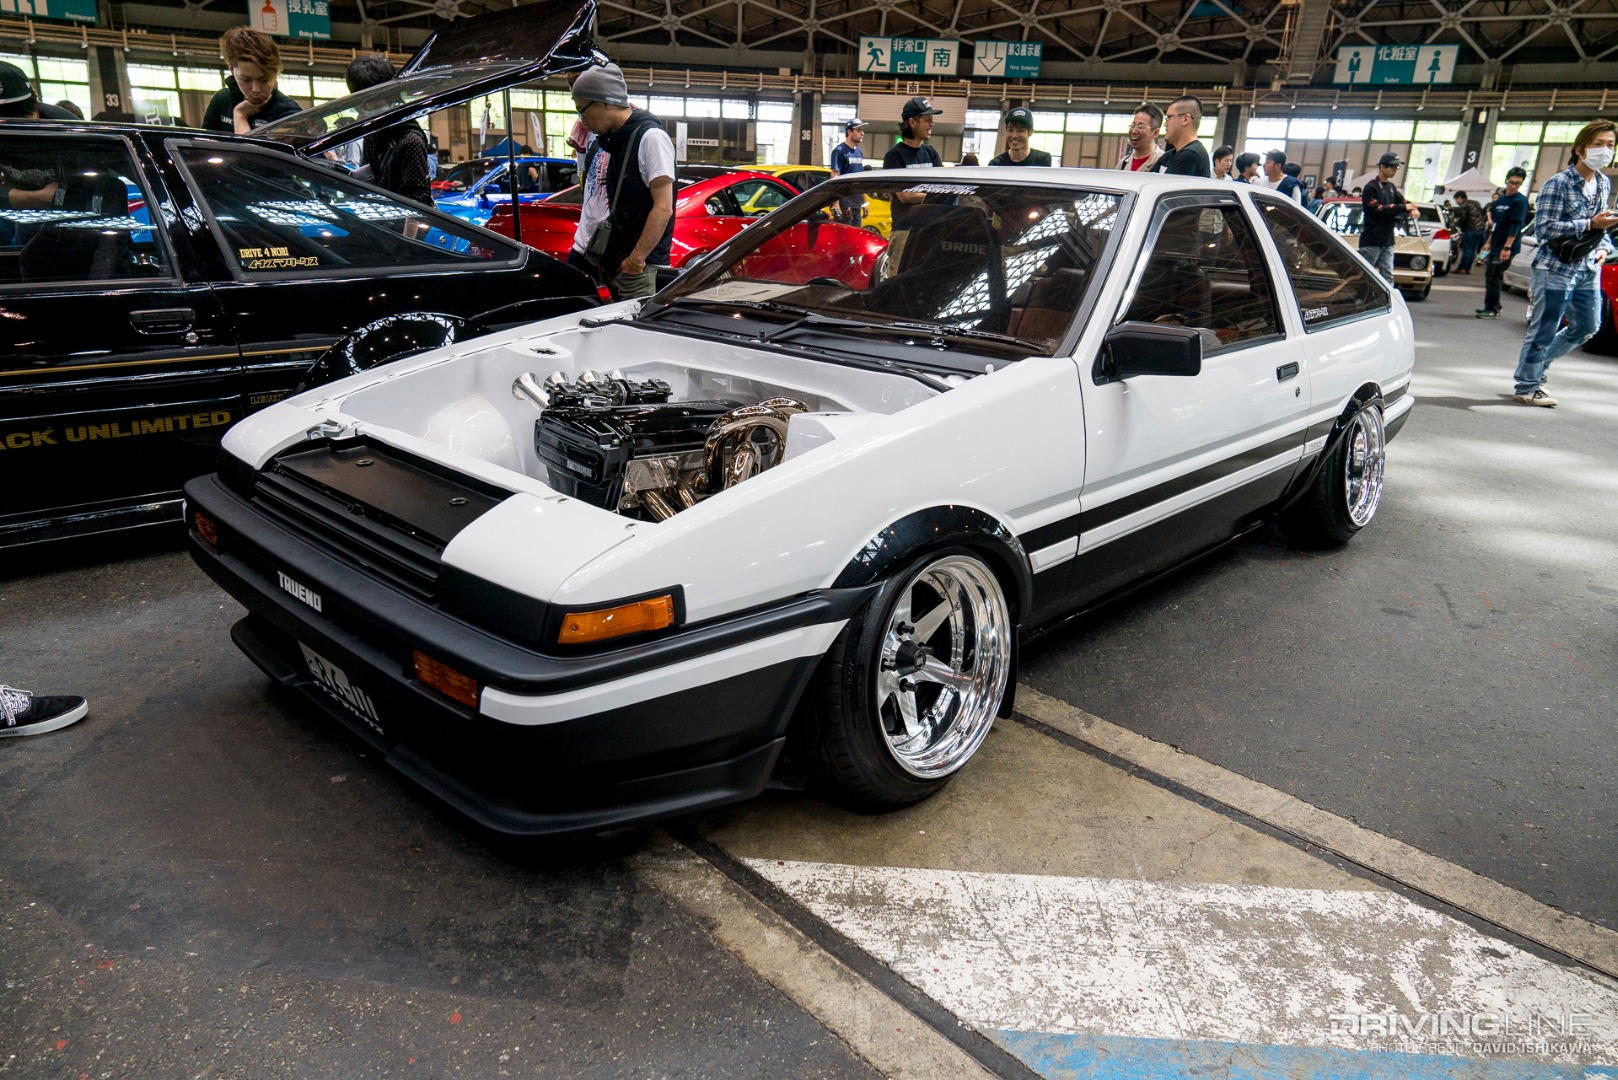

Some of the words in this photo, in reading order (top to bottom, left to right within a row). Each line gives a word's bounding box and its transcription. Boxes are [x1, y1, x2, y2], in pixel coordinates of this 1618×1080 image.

[288, 0, 328, 16] 授乳室
[892, 38, 926, 53] 非常口
[1007, 43, 1041, 57] 第3展示館
[932, 48, 951, 68] 南
[1378, 46, 1418, 61] 化粧室
[897, 61, 918, 74] Exit
[106, 93, 119, 107] 33
[801, 129, 811, 141] 36
[1467, 151, 1477, 163] 3
[239, 248, 263, 258] DRIVE
[264, 247, 270, 257] 4
[270, 247, 289, 257] NORI
[941, 241, 987, 255] BRIDE
[64, 410, 232, 443] UNLIMITED
[277, 570, 322, 613] TRUENO
